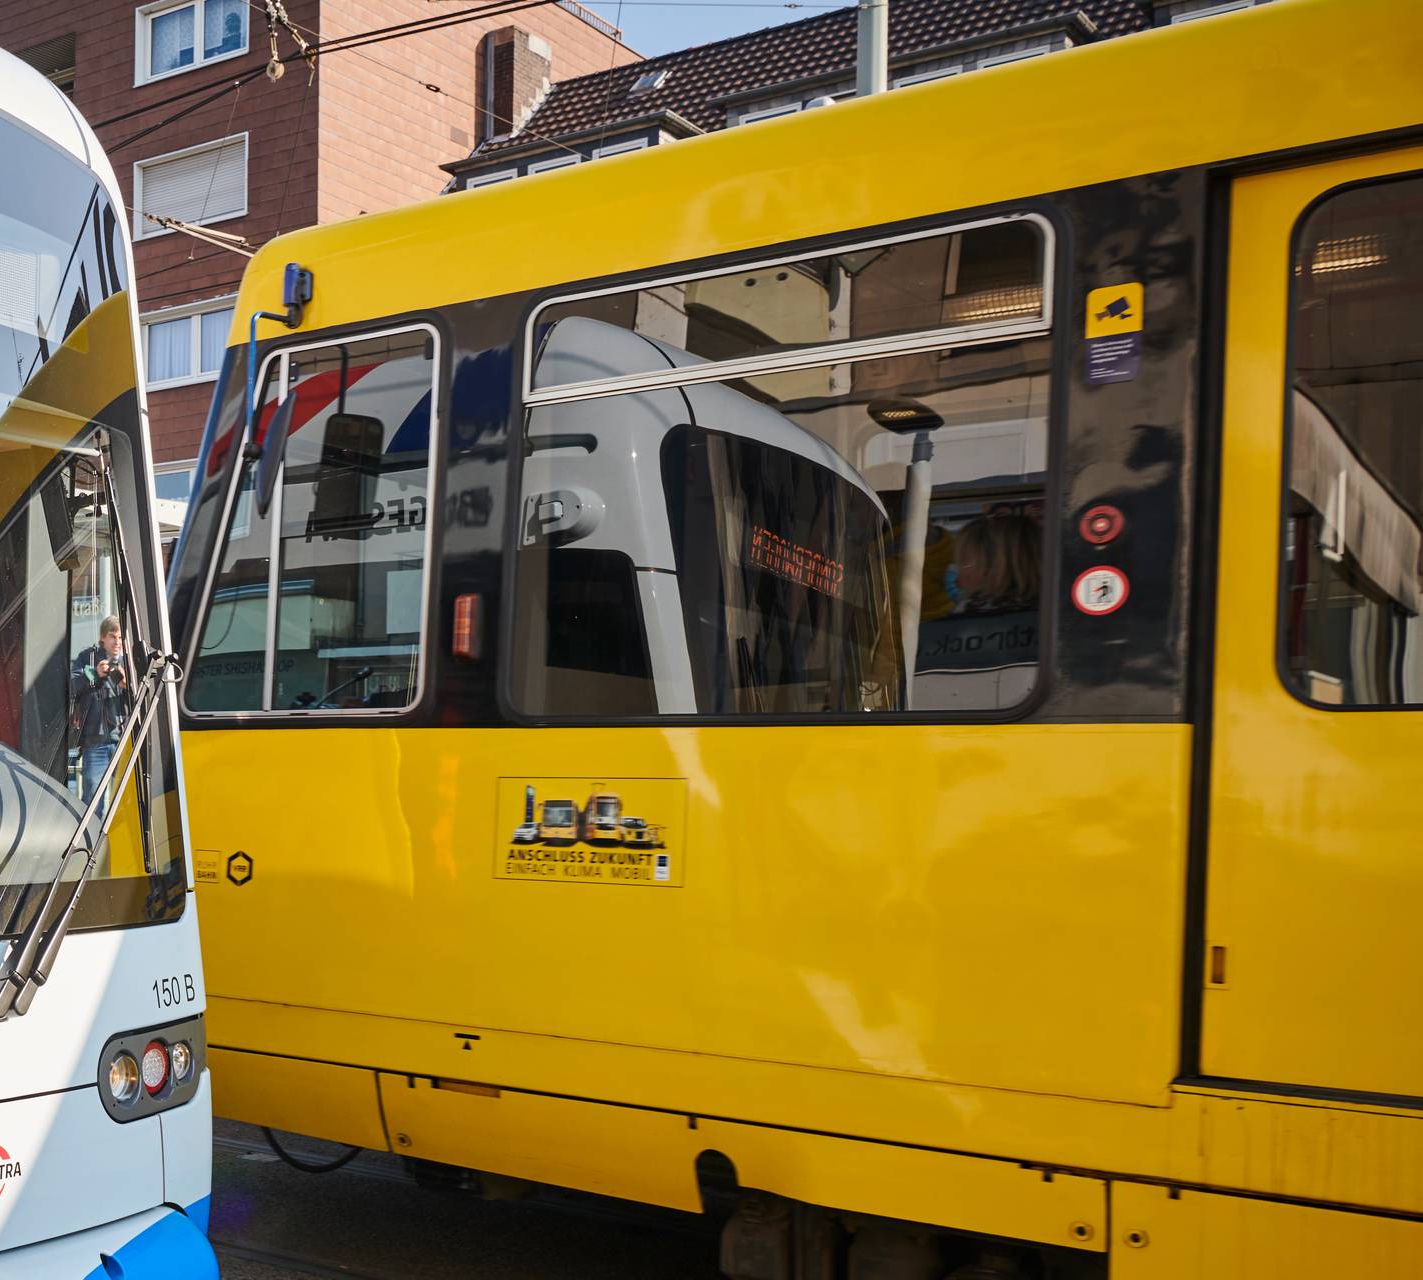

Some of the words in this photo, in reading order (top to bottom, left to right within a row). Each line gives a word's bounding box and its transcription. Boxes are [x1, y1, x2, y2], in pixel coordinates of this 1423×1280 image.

[507, 849, 585, 863] ANSCHLUSS
[590, 851, 654, 866] ZUKUNFT
[506, 862, 556, 876] EINFACH
[564, 864, 602, 878] KLIMA
[611, 866, 652, 880] MOBIL
[152, 976, 181, 1009] 150
[184, 973, 196, 1002] B
